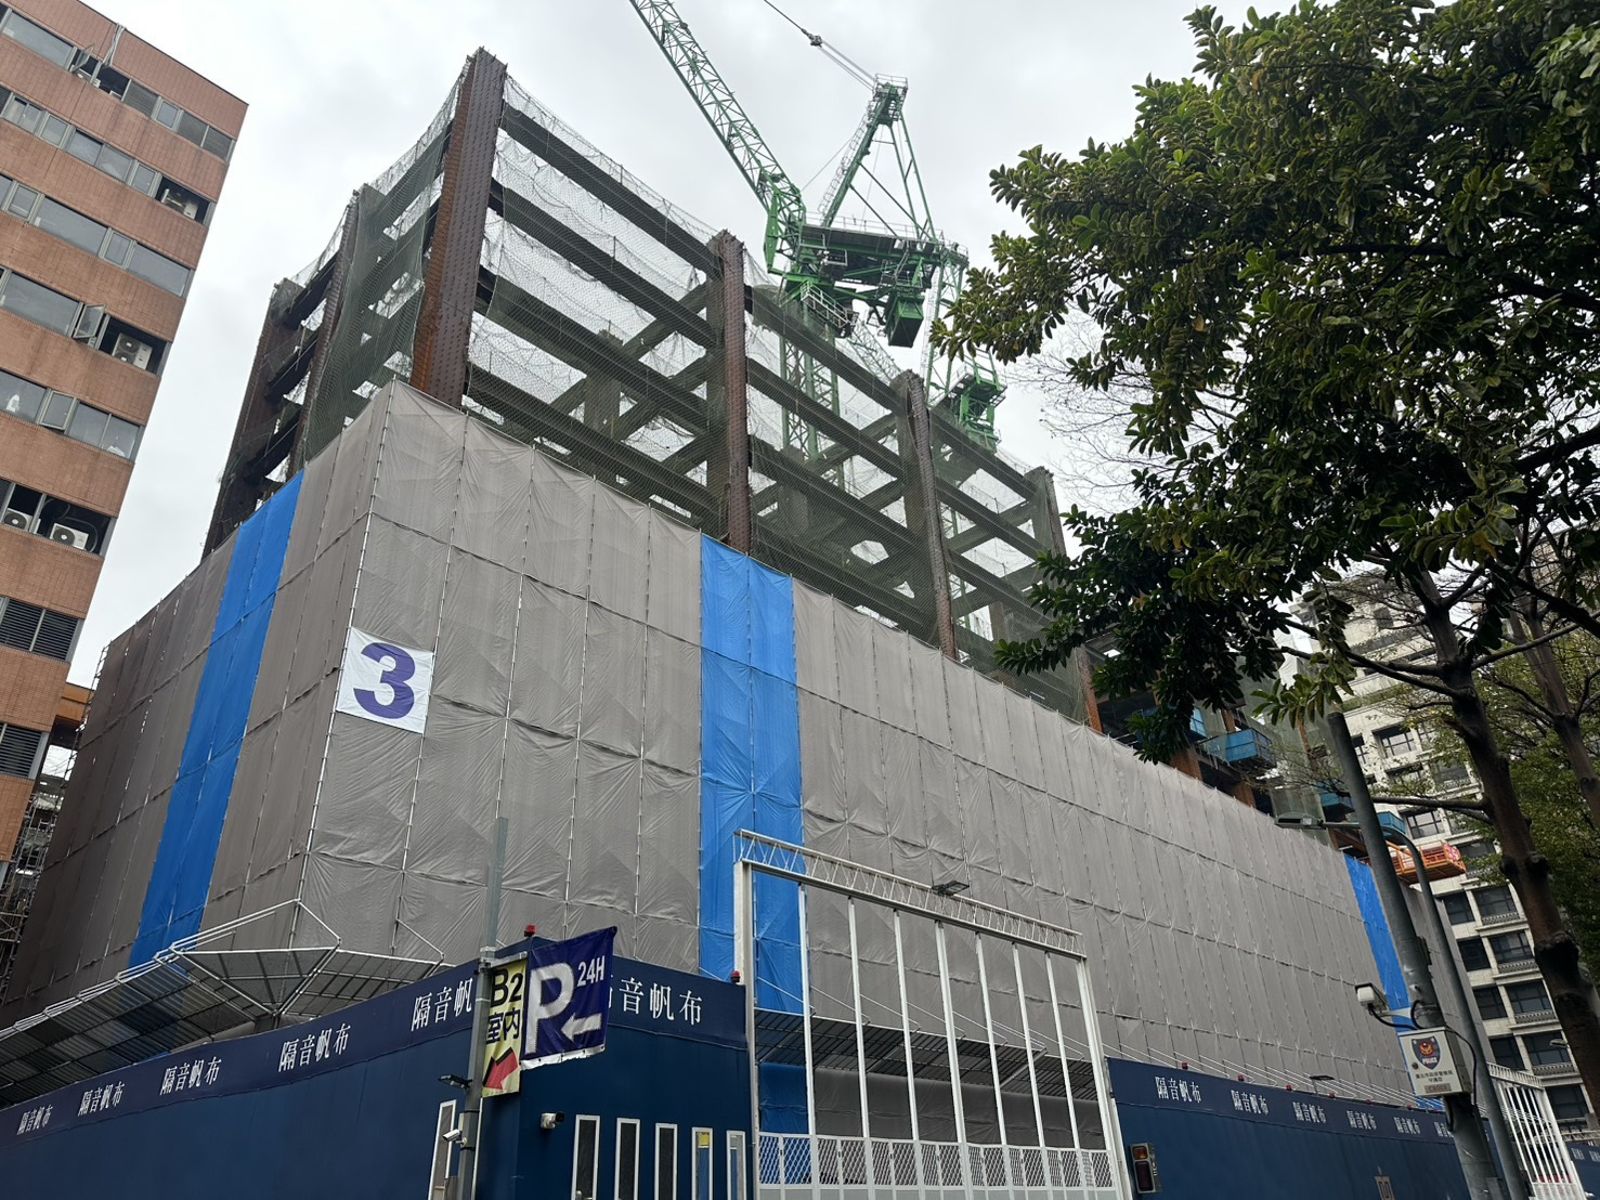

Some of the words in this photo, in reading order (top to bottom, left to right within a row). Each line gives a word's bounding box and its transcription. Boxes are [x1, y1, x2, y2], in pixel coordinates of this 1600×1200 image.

[353, 642, 415, 719] 3
[491, 967, 523, 1008] B2
[577, 955, 605, 987] 24H
[411, 977, 474, 1032] 隔音帆
[525, 962, 574, 1054] P
[608, 974, 703, 1026] 音帆布
[278, 1022, 351, 1073] 隔音帆布
[160, 1056, 222, 1096] 隔音帆布
[1155, 1076, 1202, 1103] 隔音帆布
[77, 1080, 126, 1117] 隔音帆布
[1230, 1089, 1269, 1115] 隔音帆布
[1292, 1101, 1327, 1123] 隔音帆布
[16, 1104, 54, 1135] 隔音帆布
